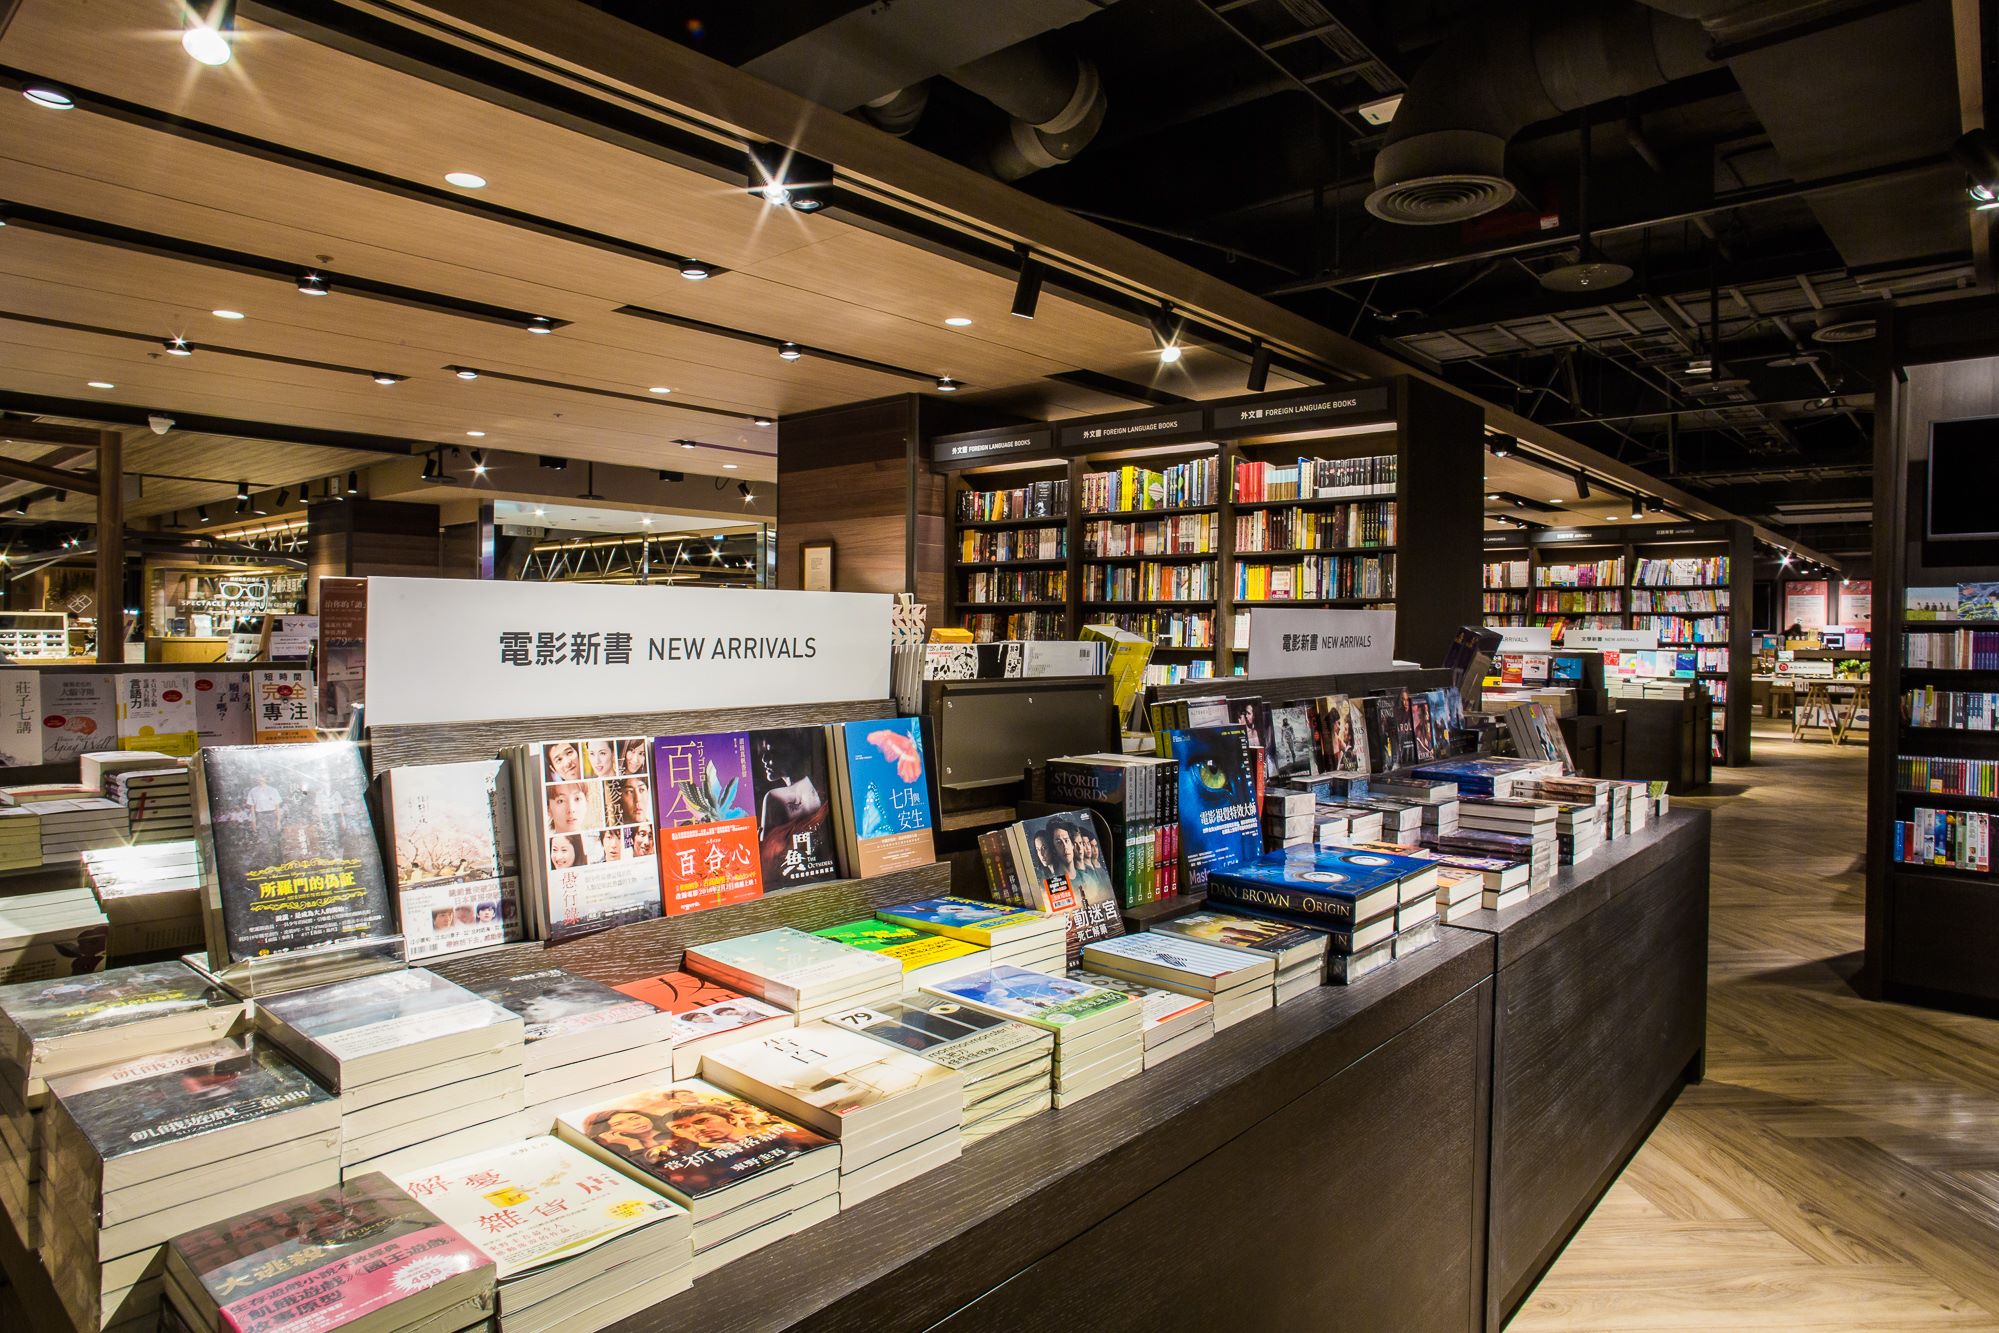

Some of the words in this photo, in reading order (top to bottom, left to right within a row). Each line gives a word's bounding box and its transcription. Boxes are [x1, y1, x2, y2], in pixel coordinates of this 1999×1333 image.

[1265, 406, 1294, 417] FOREIGN
[1295, 402, 1331, 413] LANGUAGE
[1332, 399, 1357, 408] BOOKS
[1103, 426, 1127, 436] FOREIGN
[1127, 423, 1157, 433] LANGUAGE
[1158, 420, 1178, 430] BOOKS
[968, 443, 988, 453] FOREIGN
[988, 441, 1014, 451] LANGUAGE
[1014, 439, 1031, 448] BOOKS
[499, 631, 633, 666] 電影新書
[648, 637, 705, 661] NEW
[711, 636, 816, 660] ARRIVALS
[1282, 634, 1318, 652] 電影新書
[1322, 637, 1339, 649] NEW
[1340, 635, 1372, 649] ARRIVALS
[264, 673, 302, 681] 短時間
[130, 679, 142, 709] 言語力
[262, 682, 307, 700] 完全
[10, 681, 34, 734] 莊子七講
[263, 702, 309, 721] 專注
[1380, 708, 1394, 718] KING
[697, 741, 706, 782] ユリゴコロ
[1055, 771, 1099, 787] STORM
[889, 788, 921, 809] 七月與
[1057, 786, 1108, 801] SWORDS
[898, 809, 925, 830] 安生
[1200, 802, 1257, 826] 電影視覺特效大師
[676, 843, 751, 877] 百合心
[1210, 882, 1238, 898] DAN
[1242, 887, 1290, 909] BROWN
[1302, 897, 1350, 917] ORIGIN
[841, 1012, 872, 1024] 79
[175, 1117, 229, 1137] SUZANNE
[232, 1105, 280, 1122] COLLINS
[407, 1168, 511, 1199] 解憂
[473, 1198, 569, 1233] 雜貨
[215, 1245, 328, 1296] 大逃殺
[411, 1268, 442, 1285] 499
